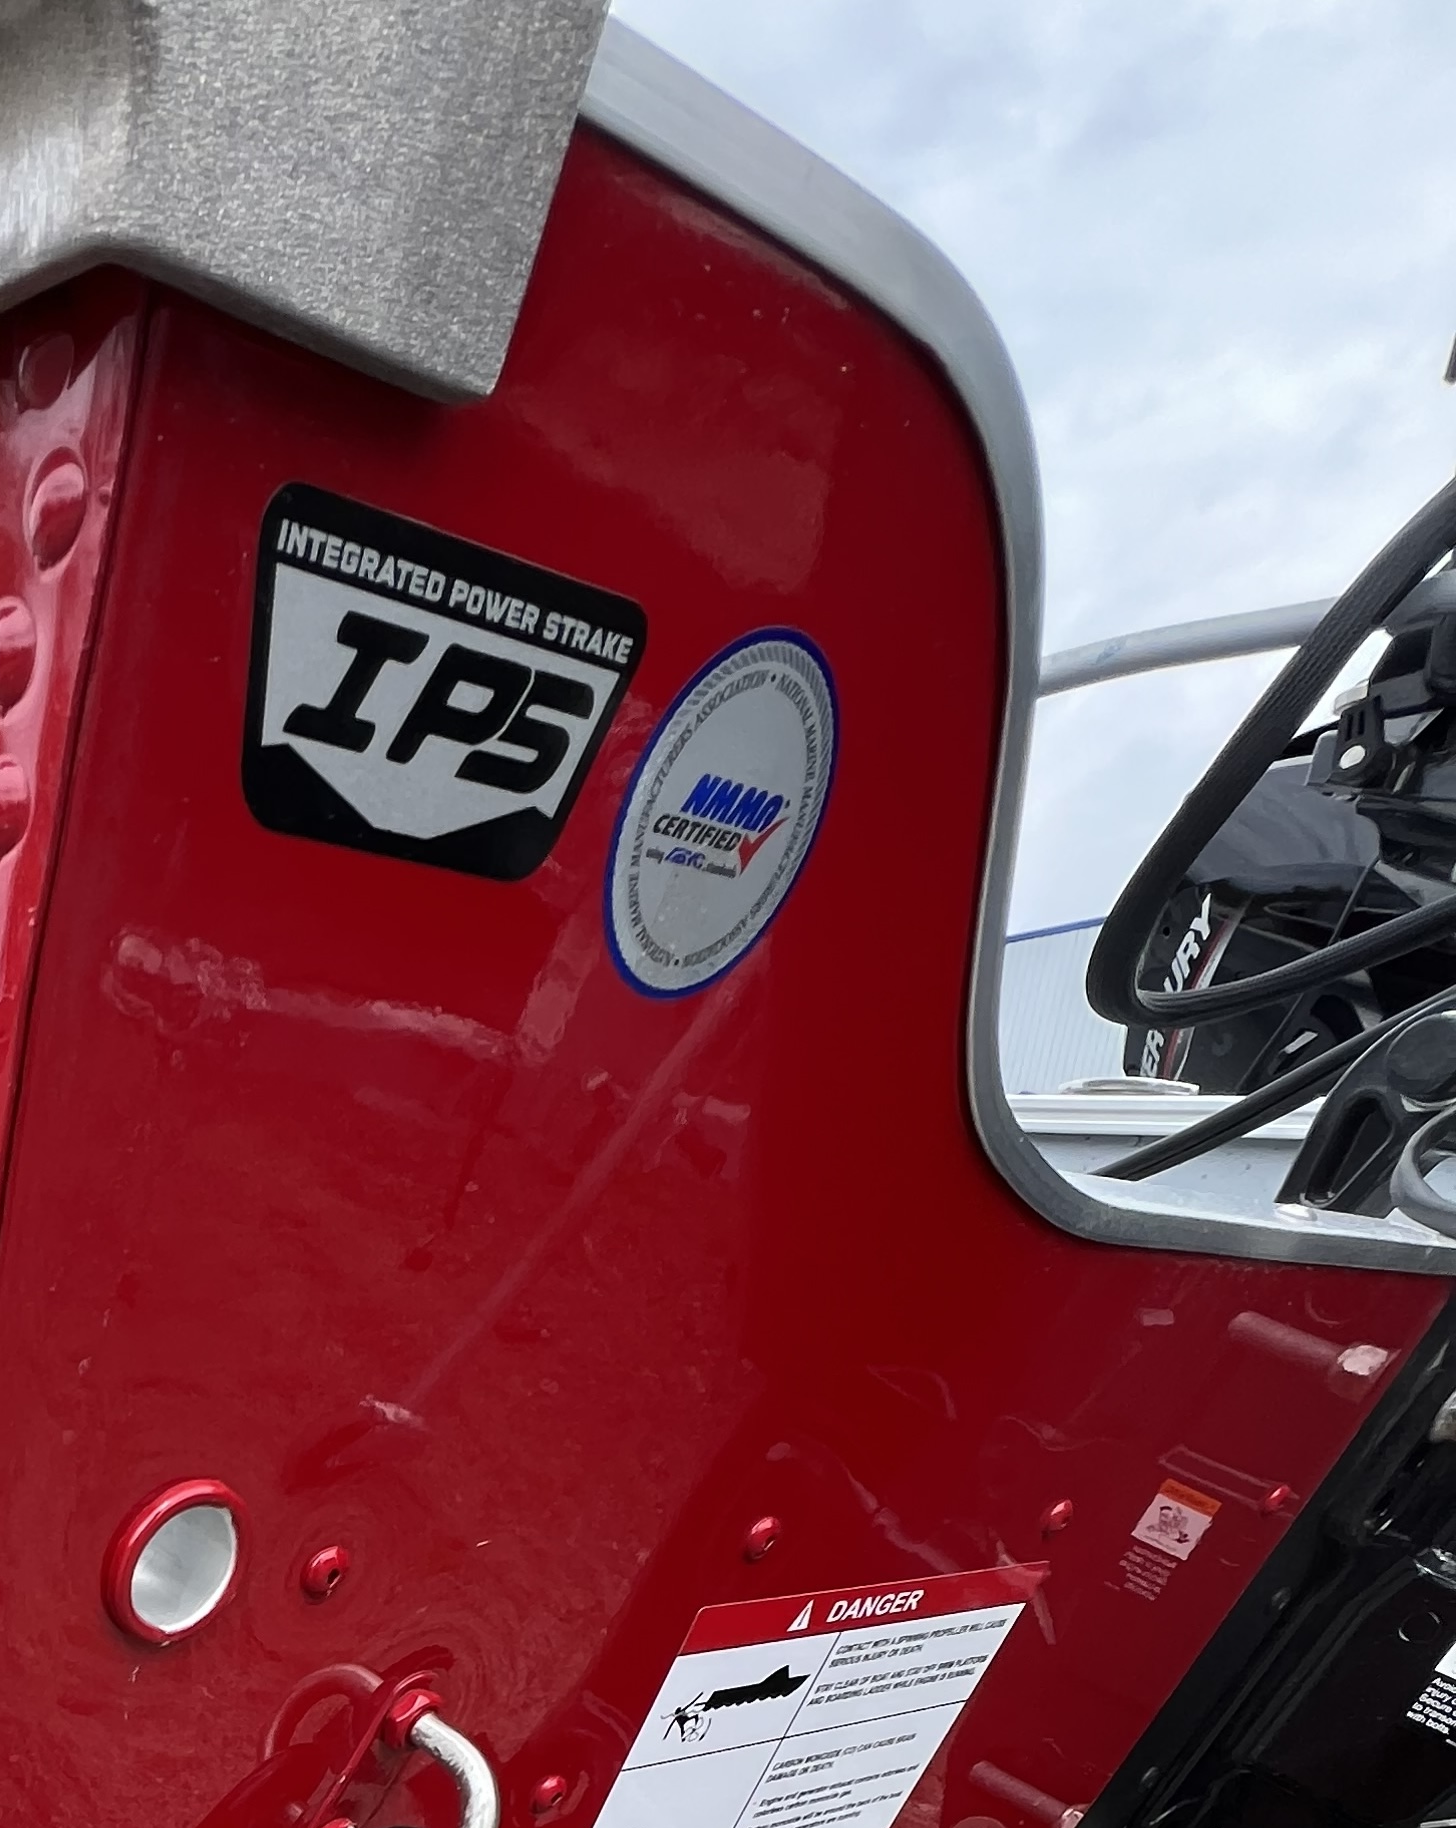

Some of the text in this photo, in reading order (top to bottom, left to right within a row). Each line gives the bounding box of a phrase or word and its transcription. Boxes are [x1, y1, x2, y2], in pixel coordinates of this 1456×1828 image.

[276, 518, 635, 665] INTEGRATED POWER STRAKE
[282, 610, 595, 794] IPS
[653, 813, 742, 851] CERTIFIED
[826, 1589, 925, 1623] DANGER
